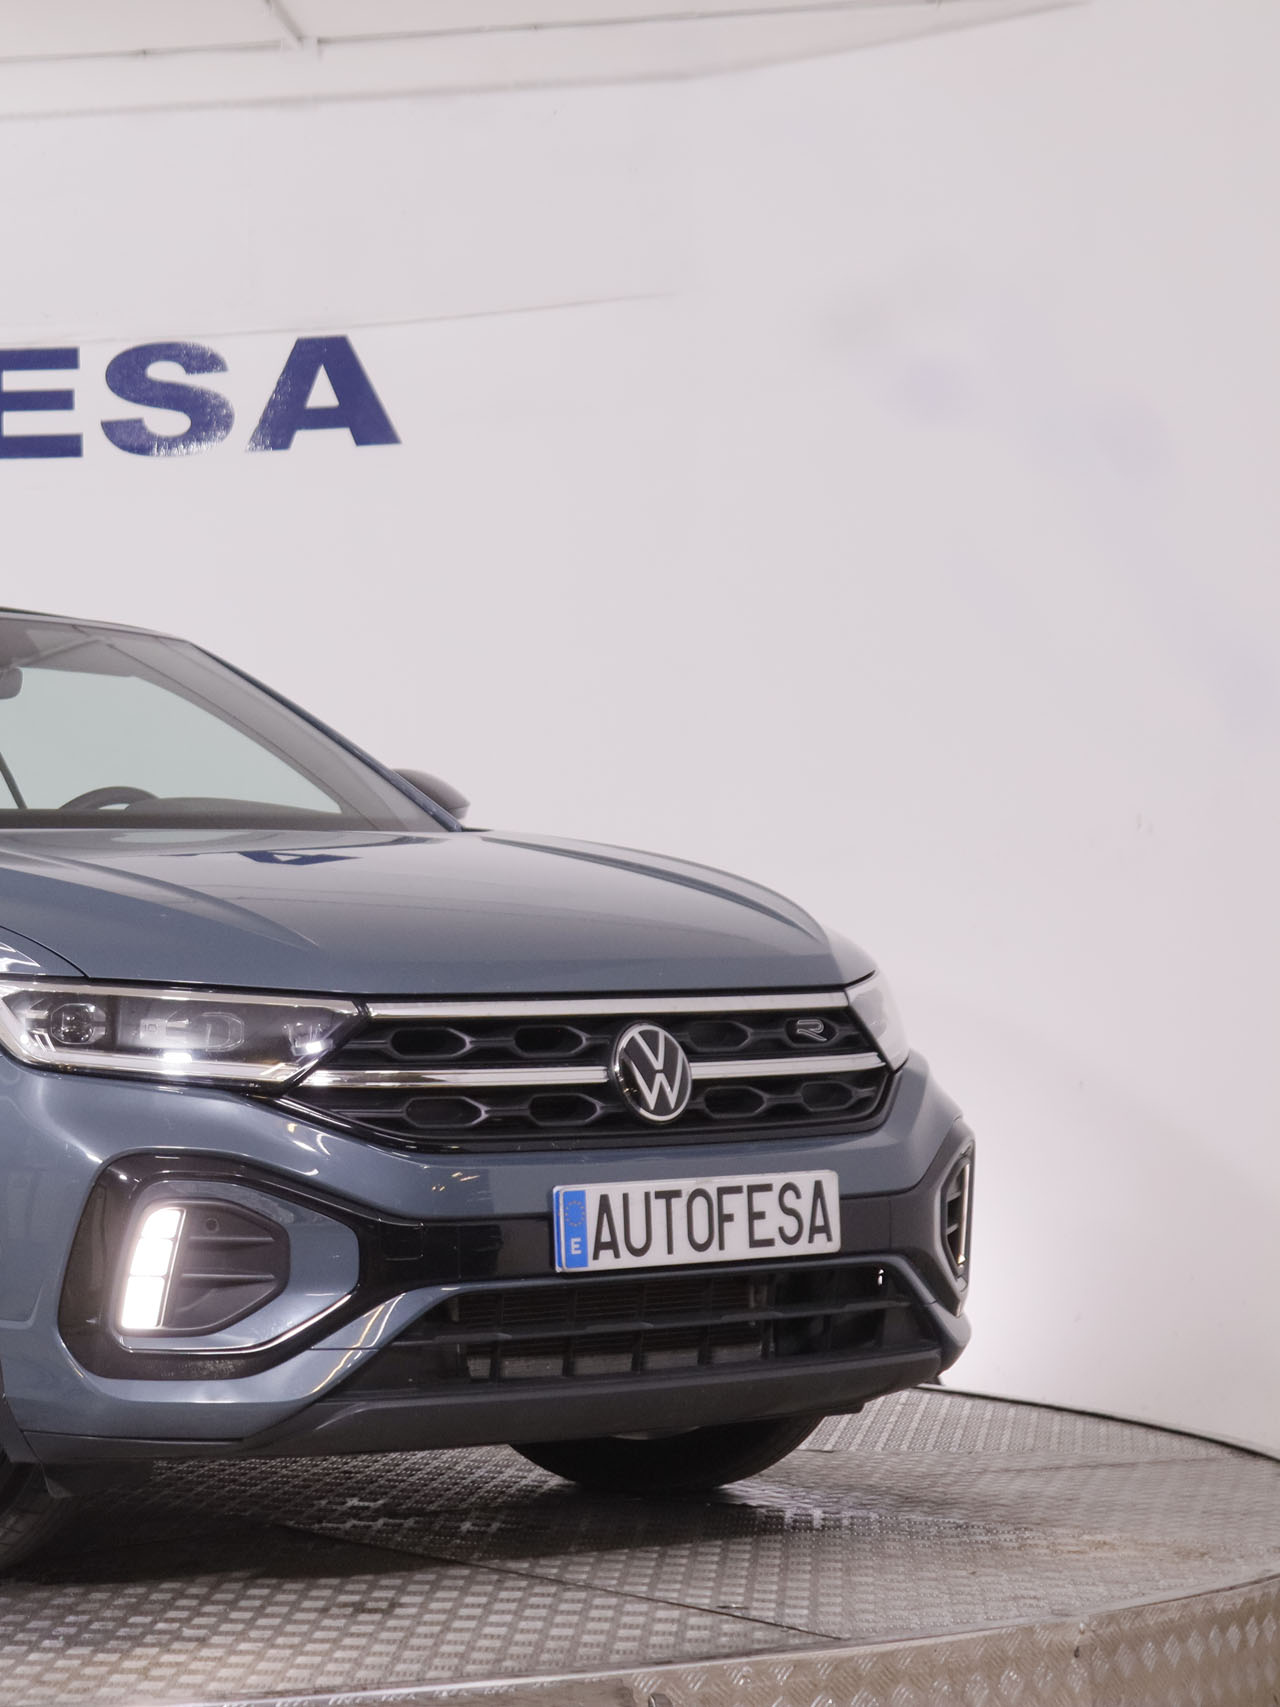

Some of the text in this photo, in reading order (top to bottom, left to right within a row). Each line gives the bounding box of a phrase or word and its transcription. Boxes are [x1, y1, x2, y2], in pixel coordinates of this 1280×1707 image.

[797, 1019, 828, 1042] R
[618, 1027, 688, 1117] VW
[571, 1238, 582, 1255] E
[592, 1180, 833, 1261] AUTOFESA
